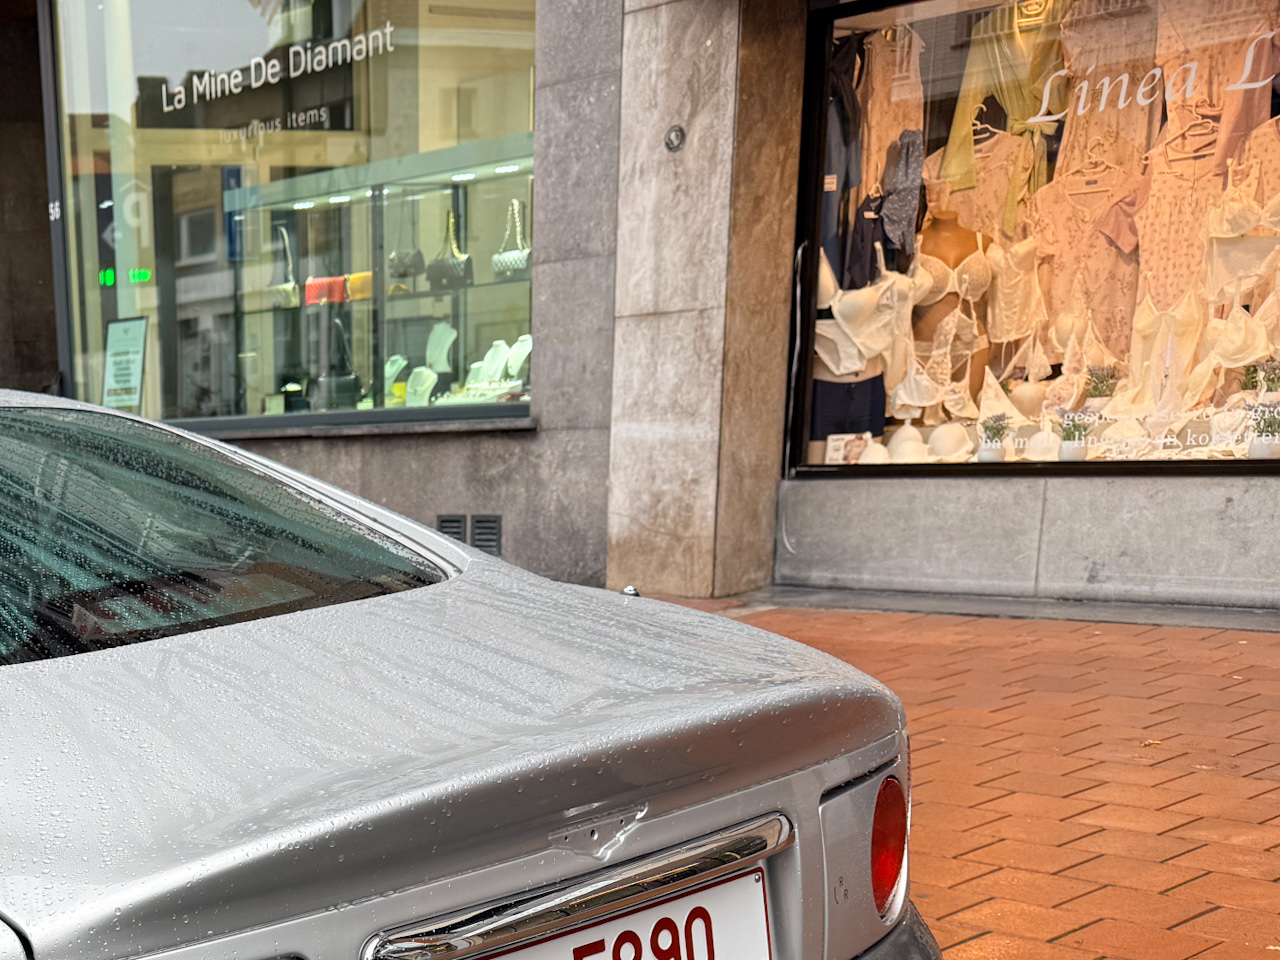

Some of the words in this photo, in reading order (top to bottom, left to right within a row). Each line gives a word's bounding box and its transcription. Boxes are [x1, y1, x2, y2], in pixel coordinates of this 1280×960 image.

[161, 83, 186, 113] La
[192, 68, 243, 104] Mine
[250, 56, 281, 89] De
[289, 20, 395, 79] Diamant
[1026, 61, 1200, 123] Linea
[287, 106, 328, 129] items
[48, 200, 61, 221] 56
